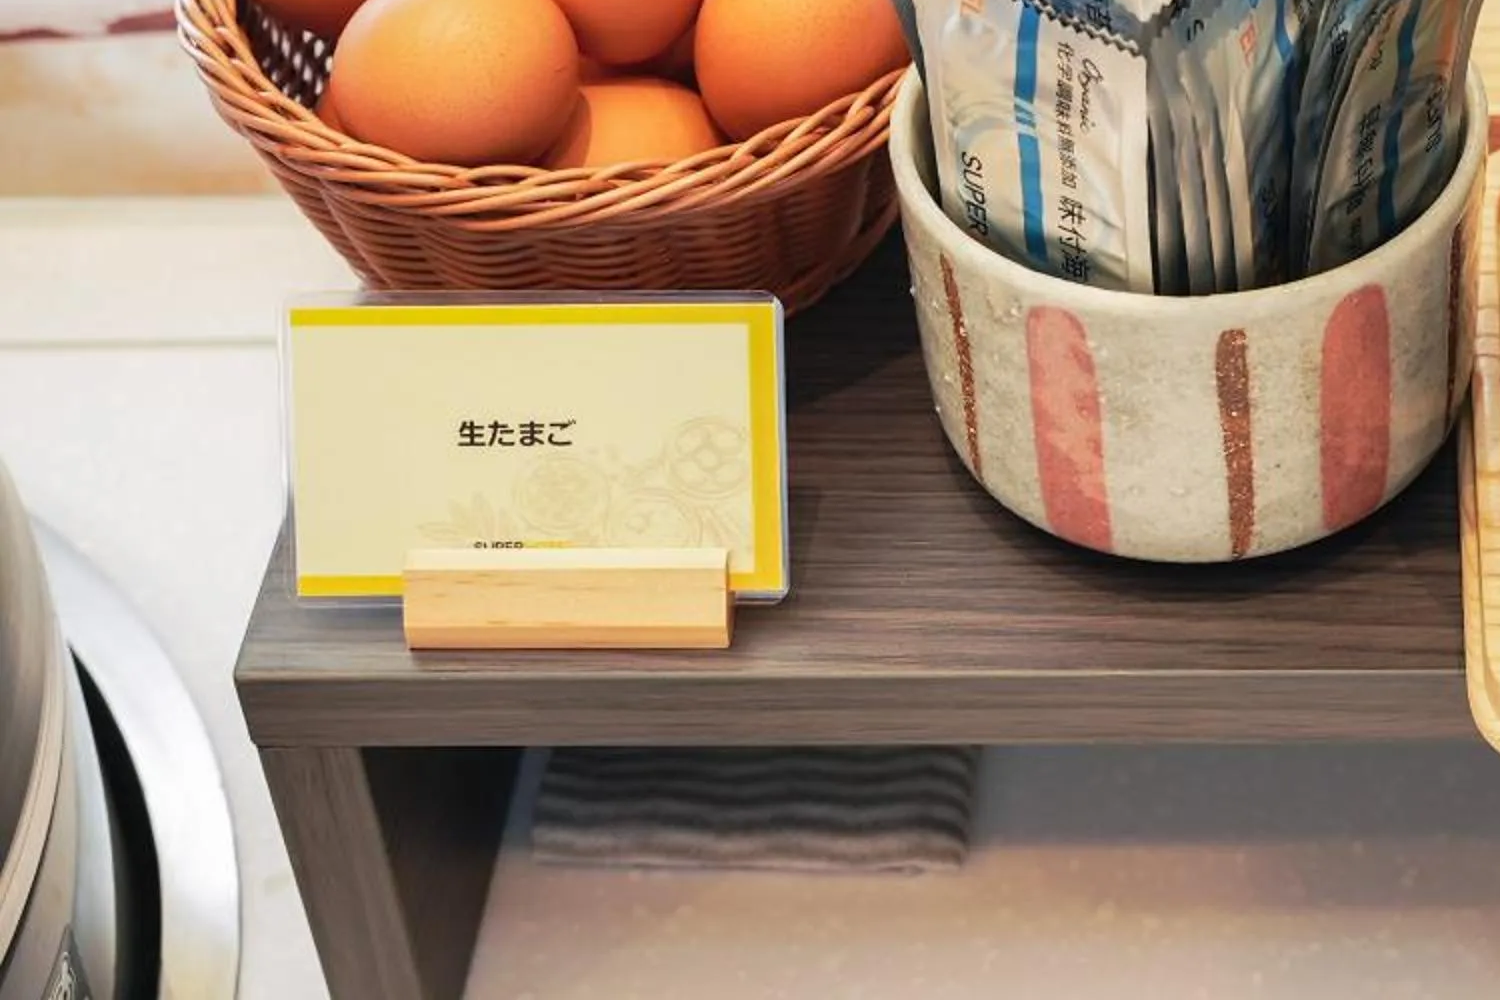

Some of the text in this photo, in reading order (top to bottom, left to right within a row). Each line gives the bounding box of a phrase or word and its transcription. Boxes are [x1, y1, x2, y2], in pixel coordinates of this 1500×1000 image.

[961, 151, 989, 236] SUPER
[458, 418, 577, 448] 生たまご
